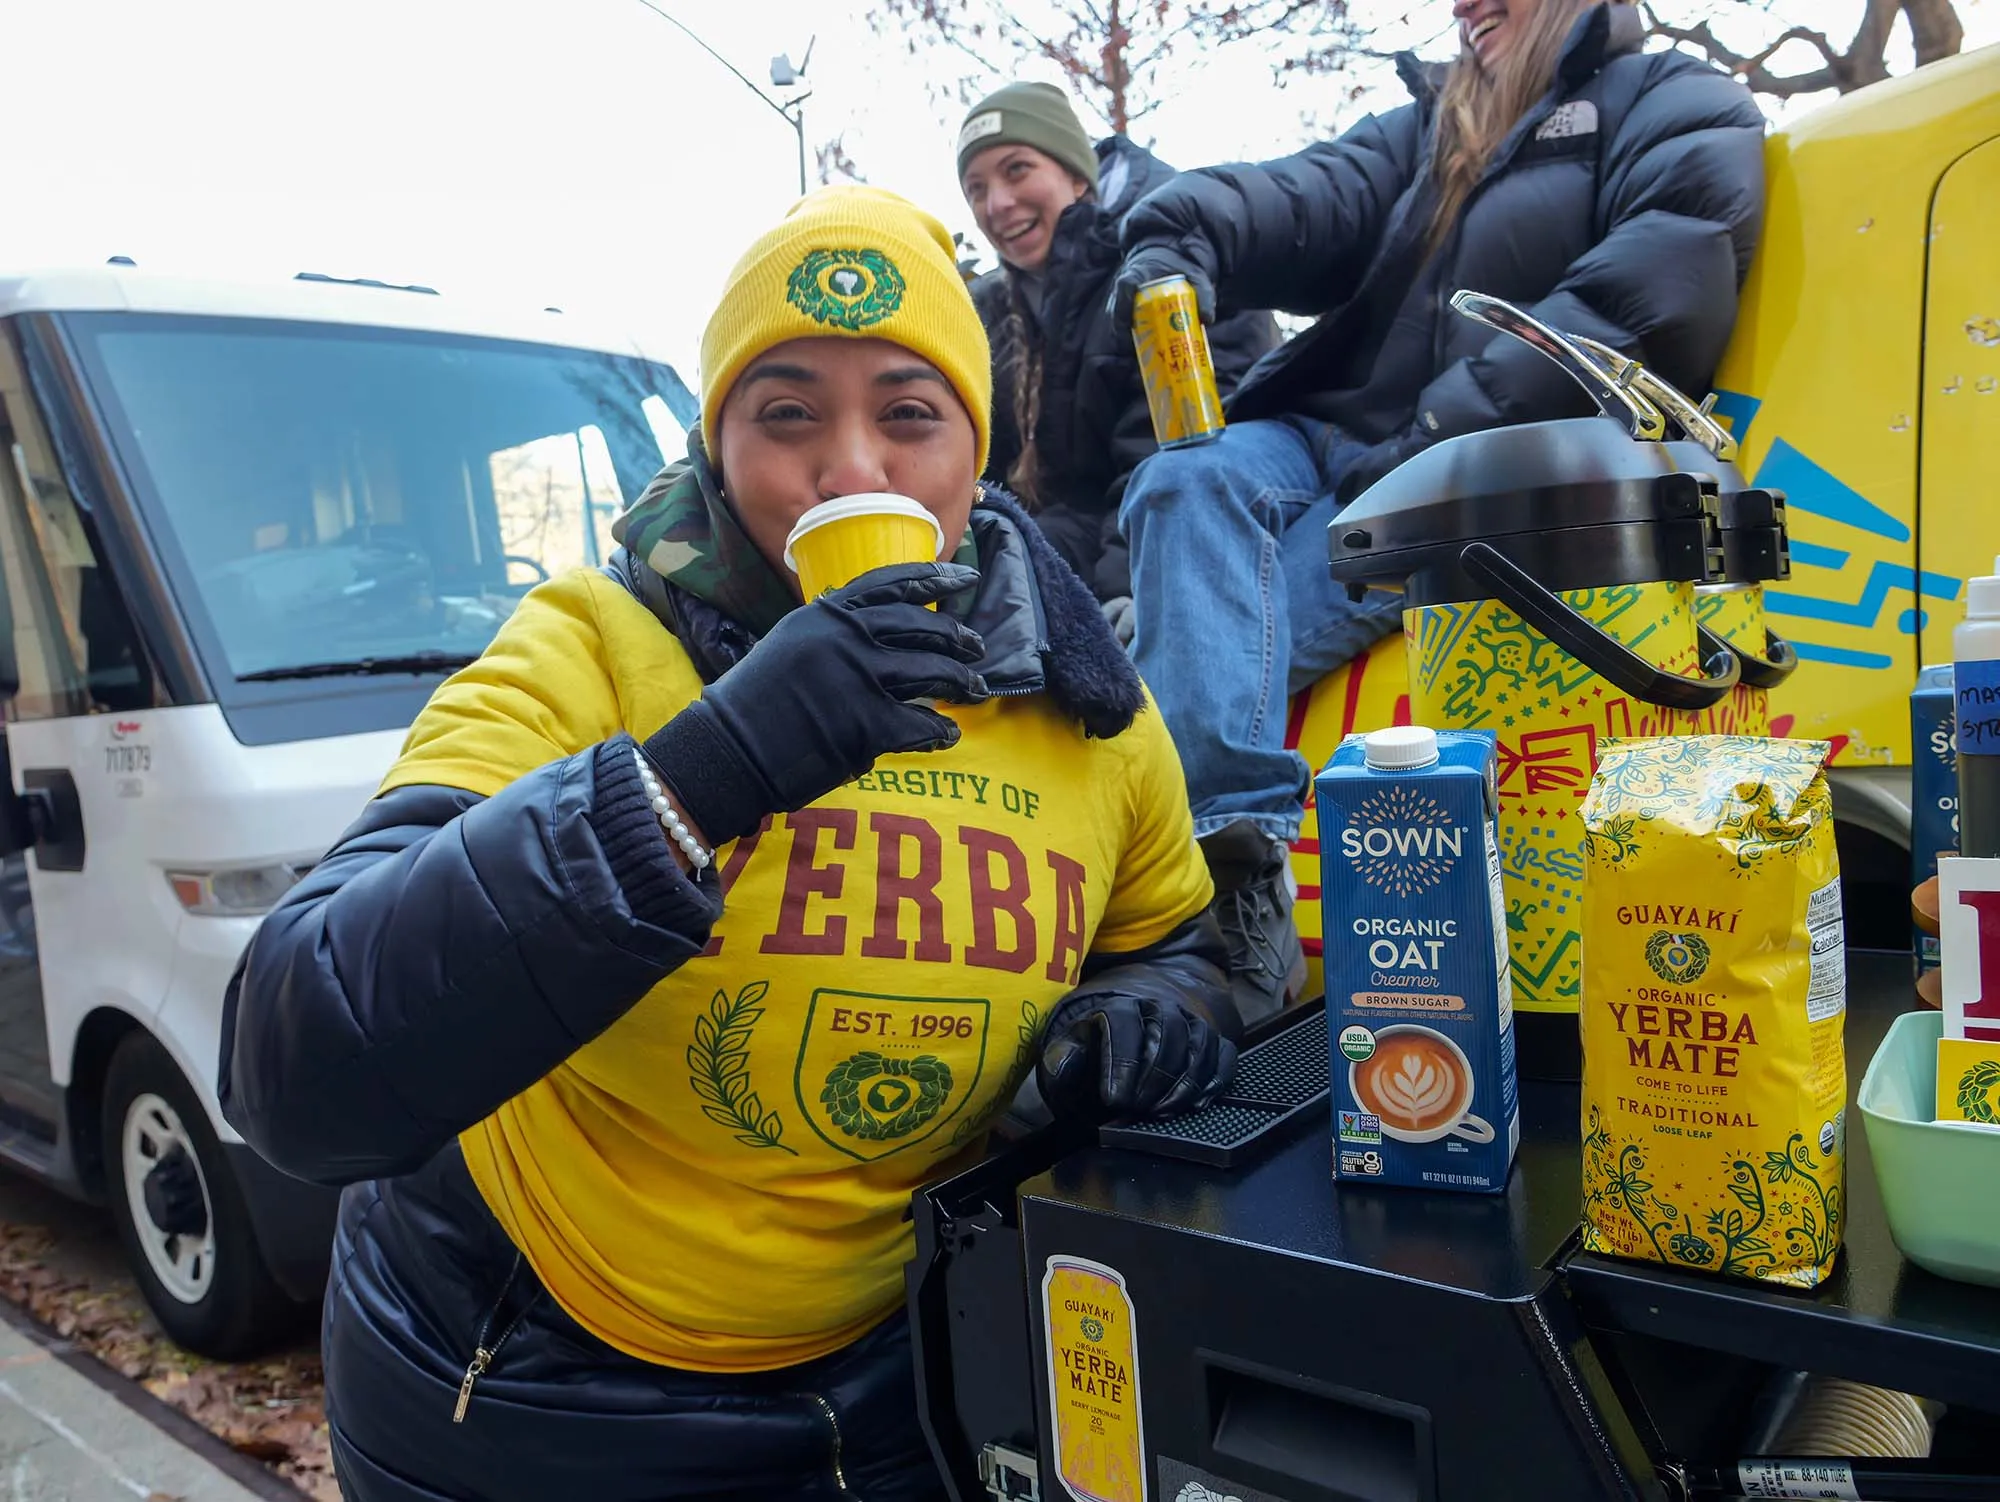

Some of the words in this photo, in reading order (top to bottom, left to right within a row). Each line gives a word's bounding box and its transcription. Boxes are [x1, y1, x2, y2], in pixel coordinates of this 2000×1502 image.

[1158, 339, 1204, 362] YERB
[843, 769, 990, 805] ERSITY
[1001, 783, 1040, 819] OF
[1341, 827, 1463, 857] SOWN
[1352, 918, 1457, 937] ORGANIC
[1616, 904, 1743, 934] GUAYAKÍ
[1368, 940, 1445, 970] OAT
[1371, 971, 1440, 988] Creamer
[1366, 995, 1408, 1006] BROWN
[1412, 997, 1451, 1008] SUGAR
[1637, 987, 1716, 1007] ORGANIC
[829, 1007, 897, 1036] EST.
[910, 1013, 974, 1039] 1996
[1608, 1001, 1759, 1046] YERBA
[1346, 1033, 1368, 1043] USDA
[1343, 1044, 1371, 1053] ORGANIC
[1626, 1037, 1740, 1078] MATE
[1636, 1076, 1671, 1091] COME
[1676, 1080, 1693, 1093] TO
[1697, 1084, 1728, 1096] LIFE
[1616, 1096, 1759, 1128] TRADITIONAL
[1653, 1125, 1684, 1136] LOOSE
[1687, 1127, 1713, 1139] LEAF
[1341, 1156, 1365, 1165] GLUTEN
[1342, 1163, 1356, 1172] FREE
[1422, 1171, 1433, 1181] NET
[1600, 1208, 1616, 1224] Net
[1075, 1342, 1109, 1358] ORGANIC
[1060, 1348, 1128, 1385] YERBA
[1070, 1370, 1122, 1404] MATE
[1071, 1399, 1089, 1410] BERRY
[1090, 1406, 1121, 1421] LEMONADE
[1091, 1415, 1103, 1426] 20
